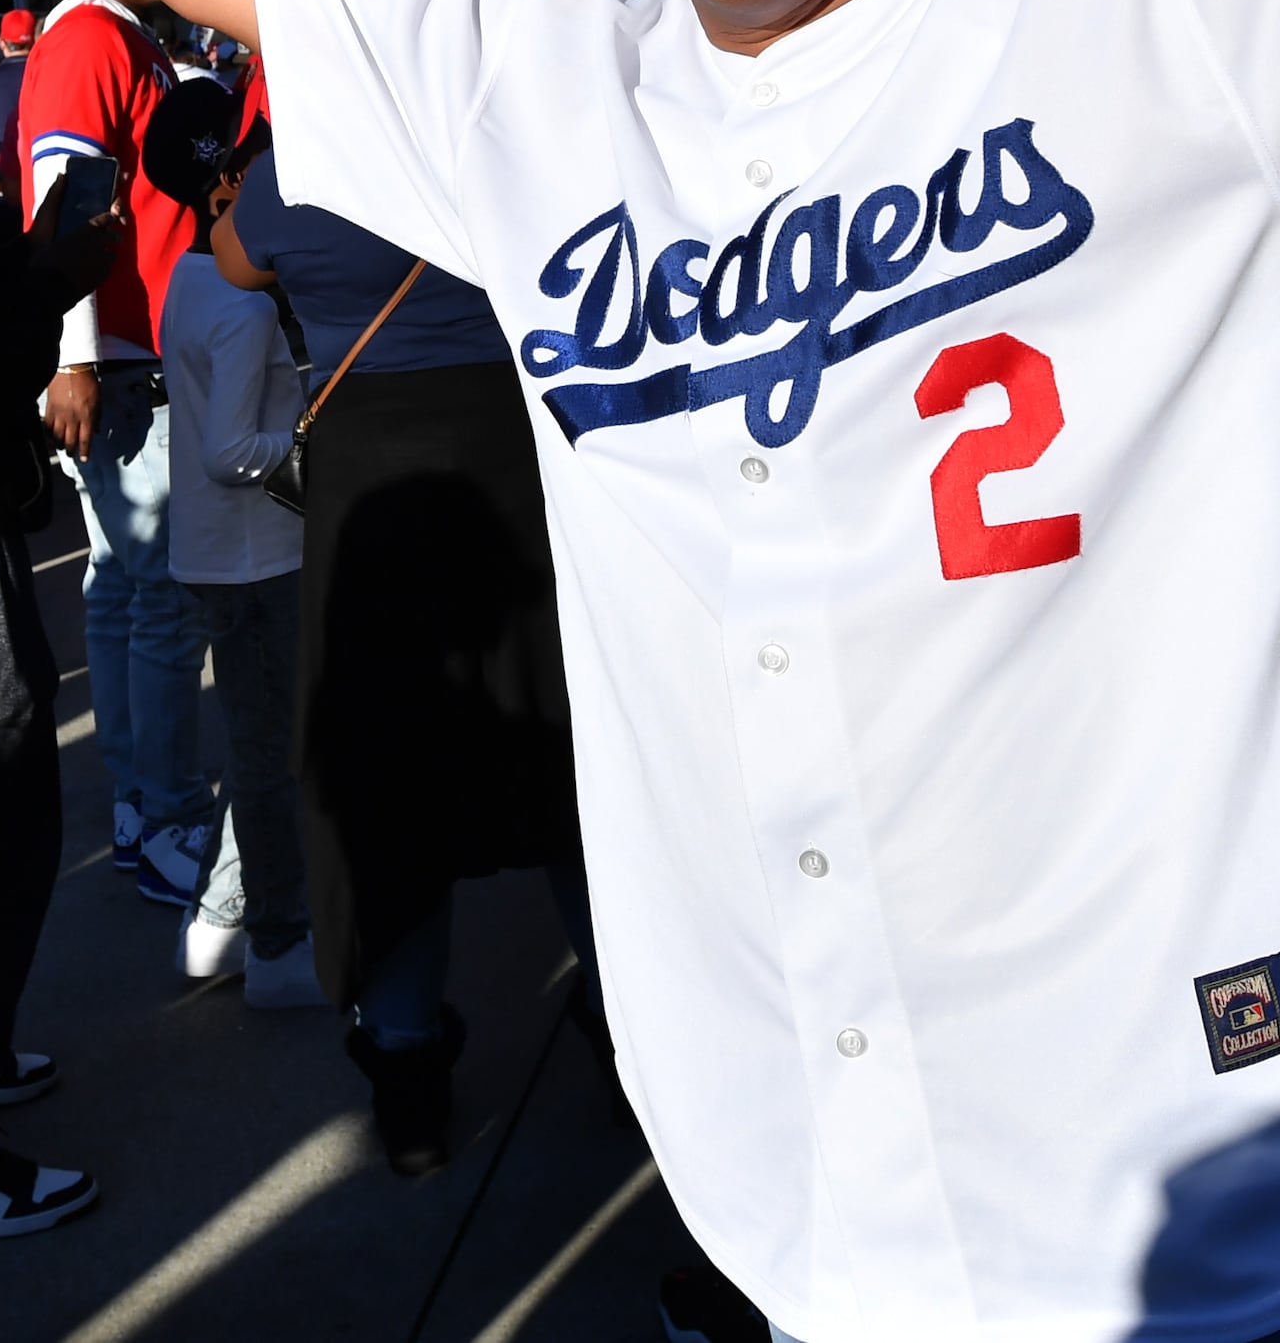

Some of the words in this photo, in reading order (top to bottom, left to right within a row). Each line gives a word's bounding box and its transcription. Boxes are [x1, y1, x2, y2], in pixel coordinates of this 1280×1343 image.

[520, 117, 1095, 450] Dodgers
[914, 332, 1082, 581] 2
[1221, 1018, 1280, 1057] COLLECTION
